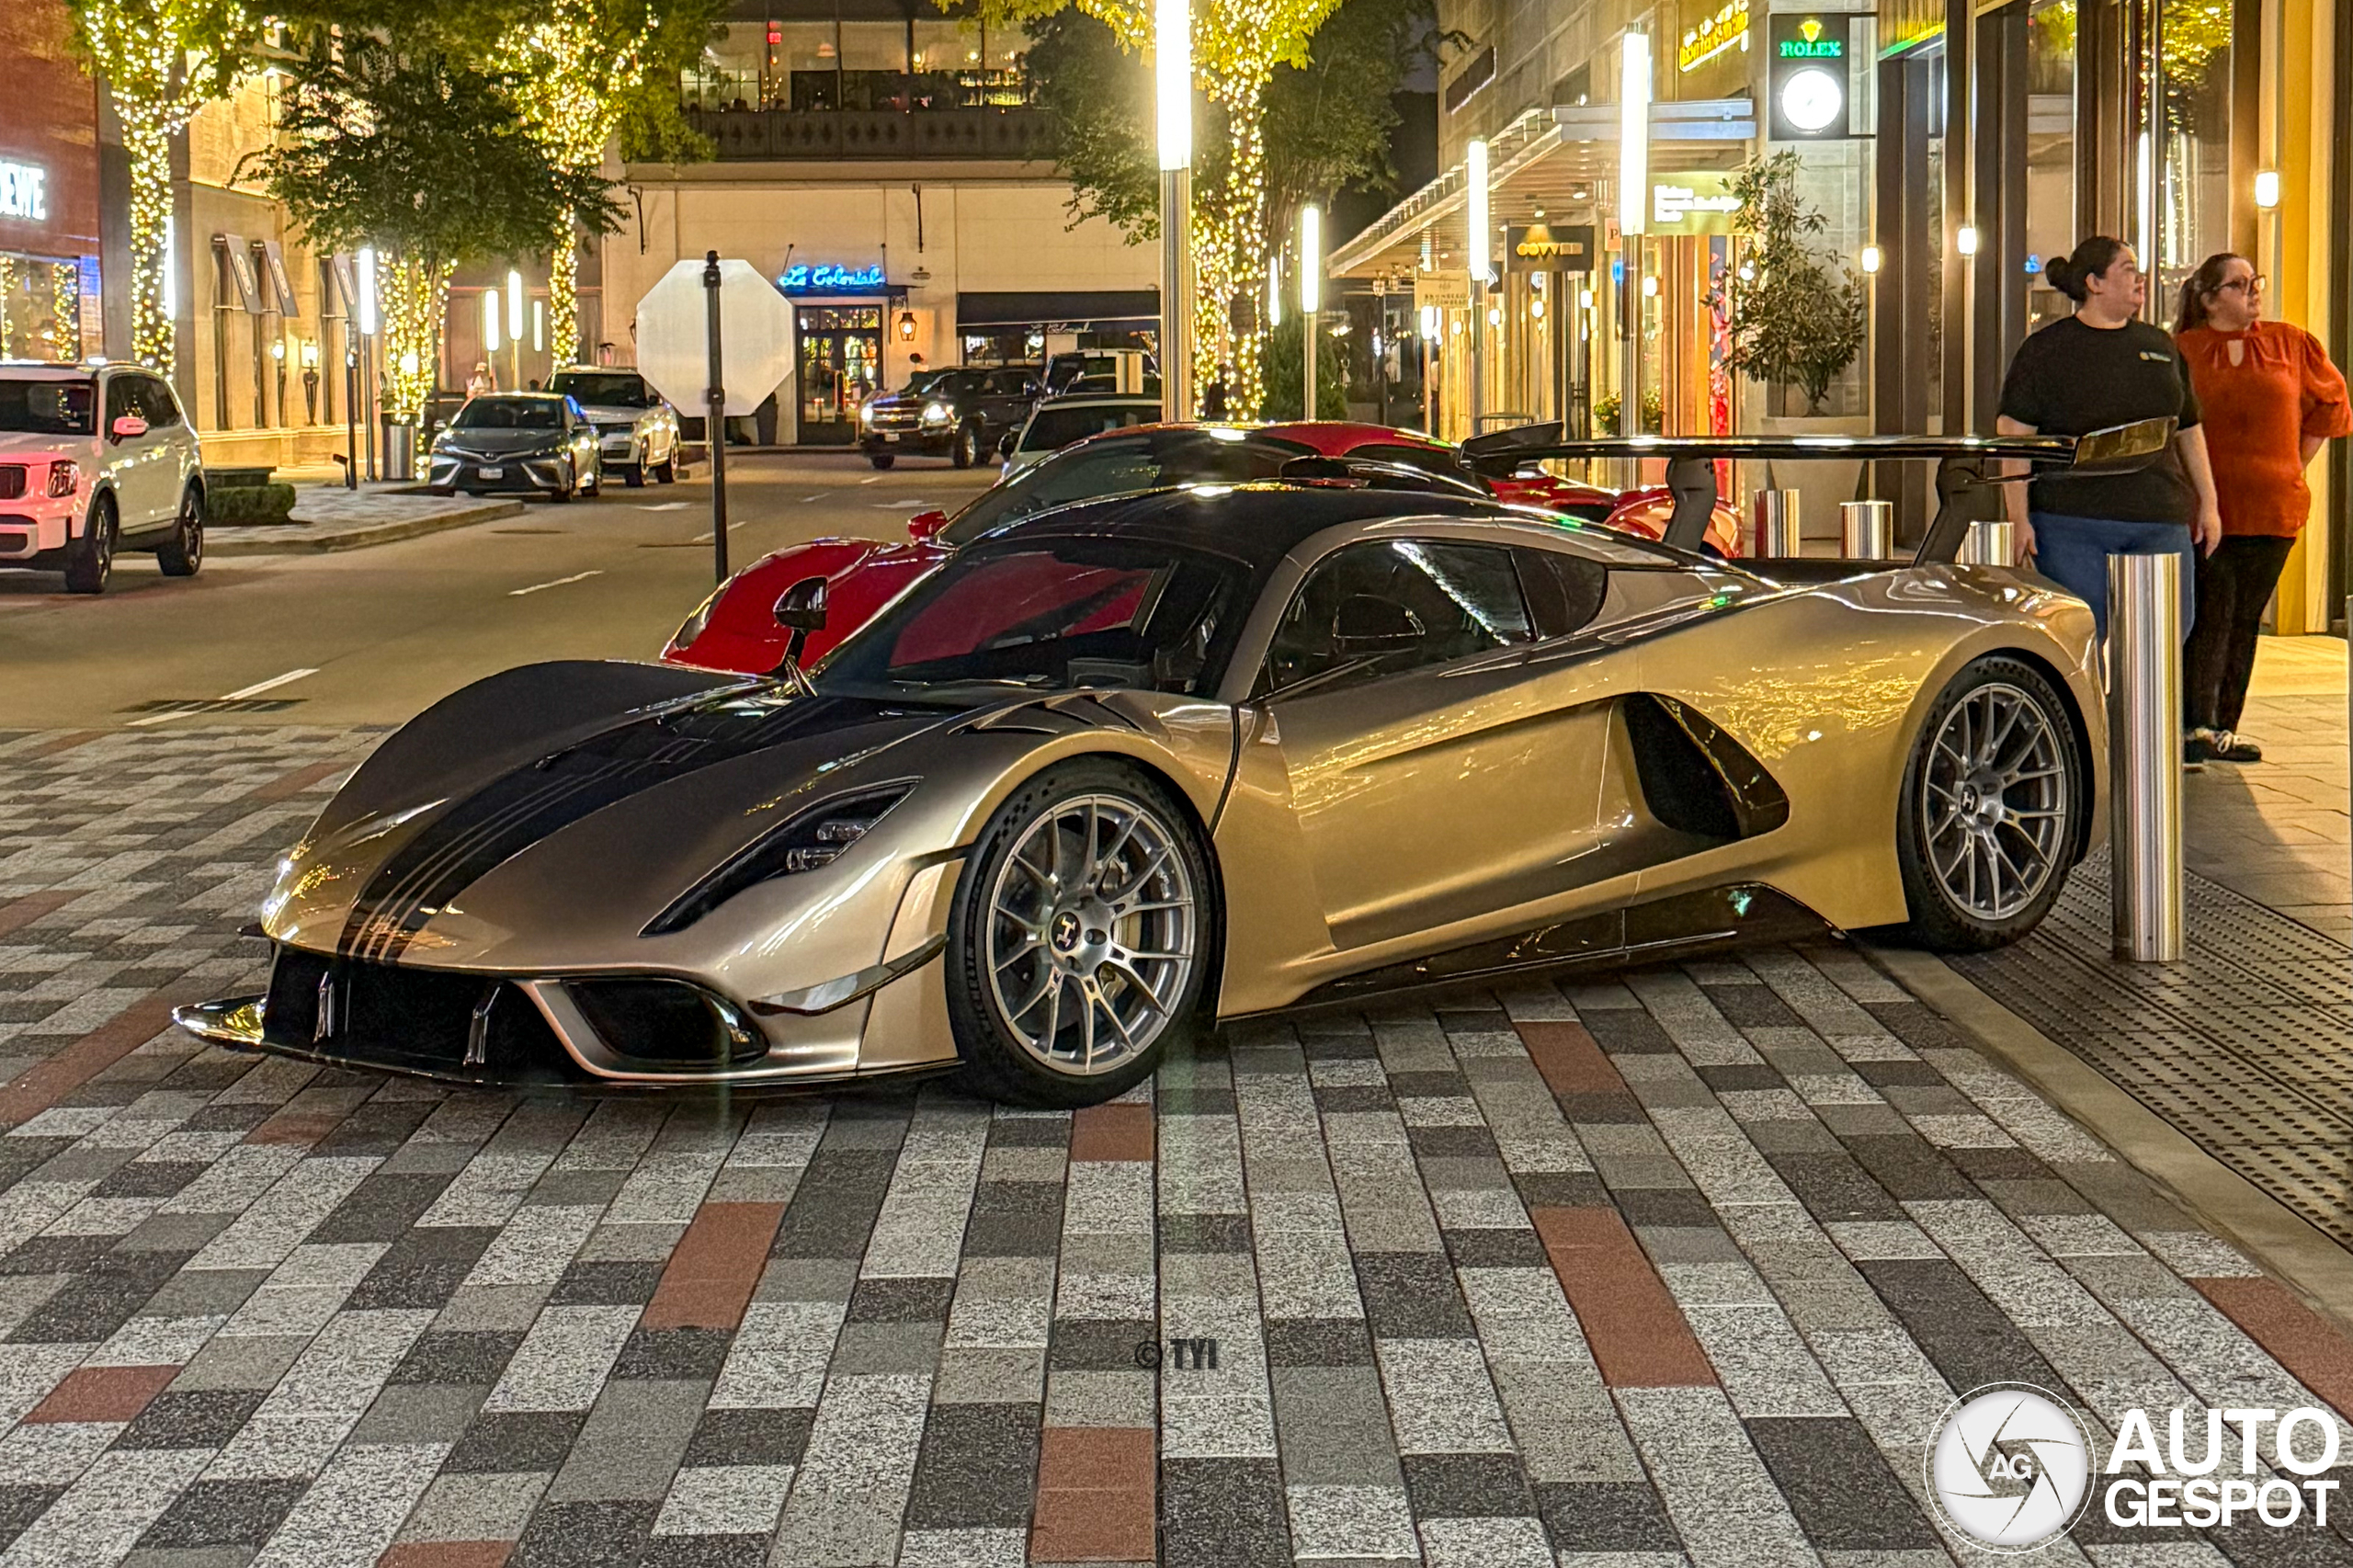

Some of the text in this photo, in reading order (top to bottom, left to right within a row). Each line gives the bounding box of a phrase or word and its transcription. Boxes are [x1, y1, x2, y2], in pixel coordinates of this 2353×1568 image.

[1779, 41, 1841, 57] ROLEX
[0, 160, 46, 221] EWE
[779, 263, 885, 286] Le Colonial
